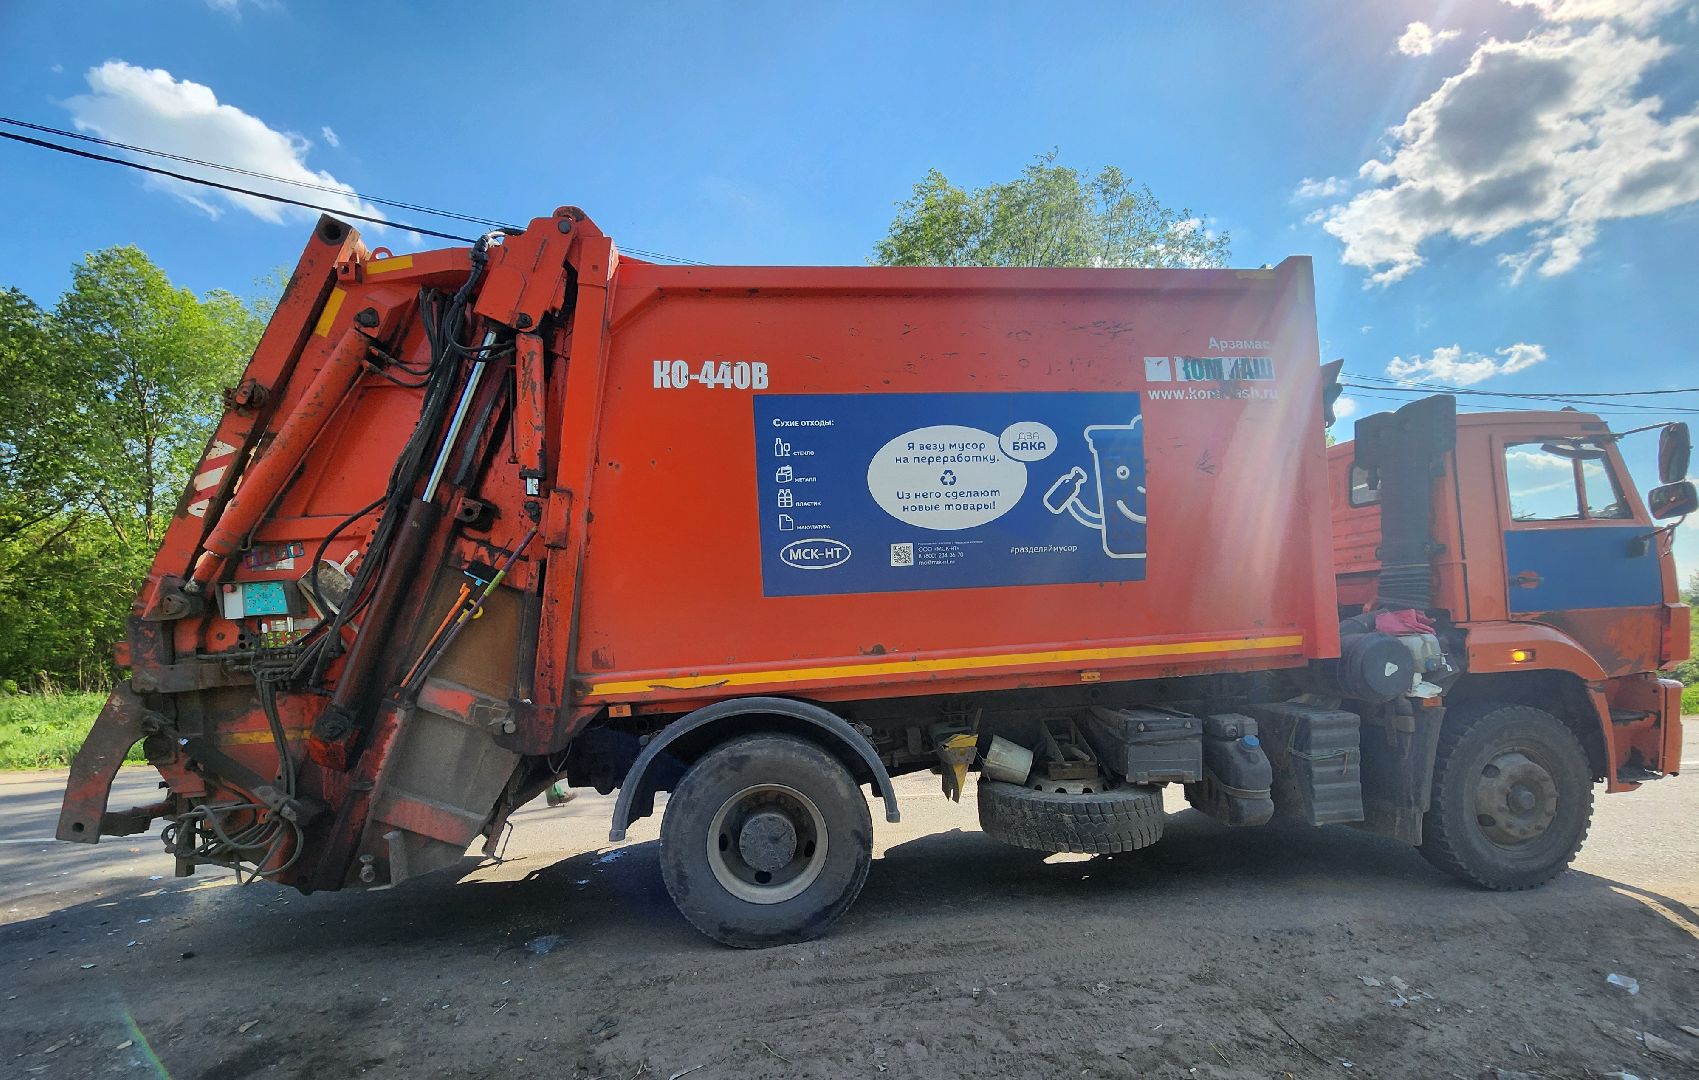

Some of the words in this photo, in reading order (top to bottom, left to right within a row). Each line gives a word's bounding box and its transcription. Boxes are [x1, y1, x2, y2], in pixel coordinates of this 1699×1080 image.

[1208, 337, 1270, 352] Арзамас
[653, 360, 768, 389] КО-440В
[907, 442, 915, 450] Я
[919, 442, 945, 452] везу
[949, 441, 986, 451] мусор
[1012, 441, 1046, 451] БАКА
[895, 455, 909, 464] на
[913, 453, 1000, 465] переработку.
[896, 491, 911, 500] Из
[914, 490, 942, 500] него
[945, 489, 1001, 499] сделают
[902, 503, 940, 512] новые
[944, 500, 996, 512] товары!
[789, 547, 842, 560] МСК-НТ
